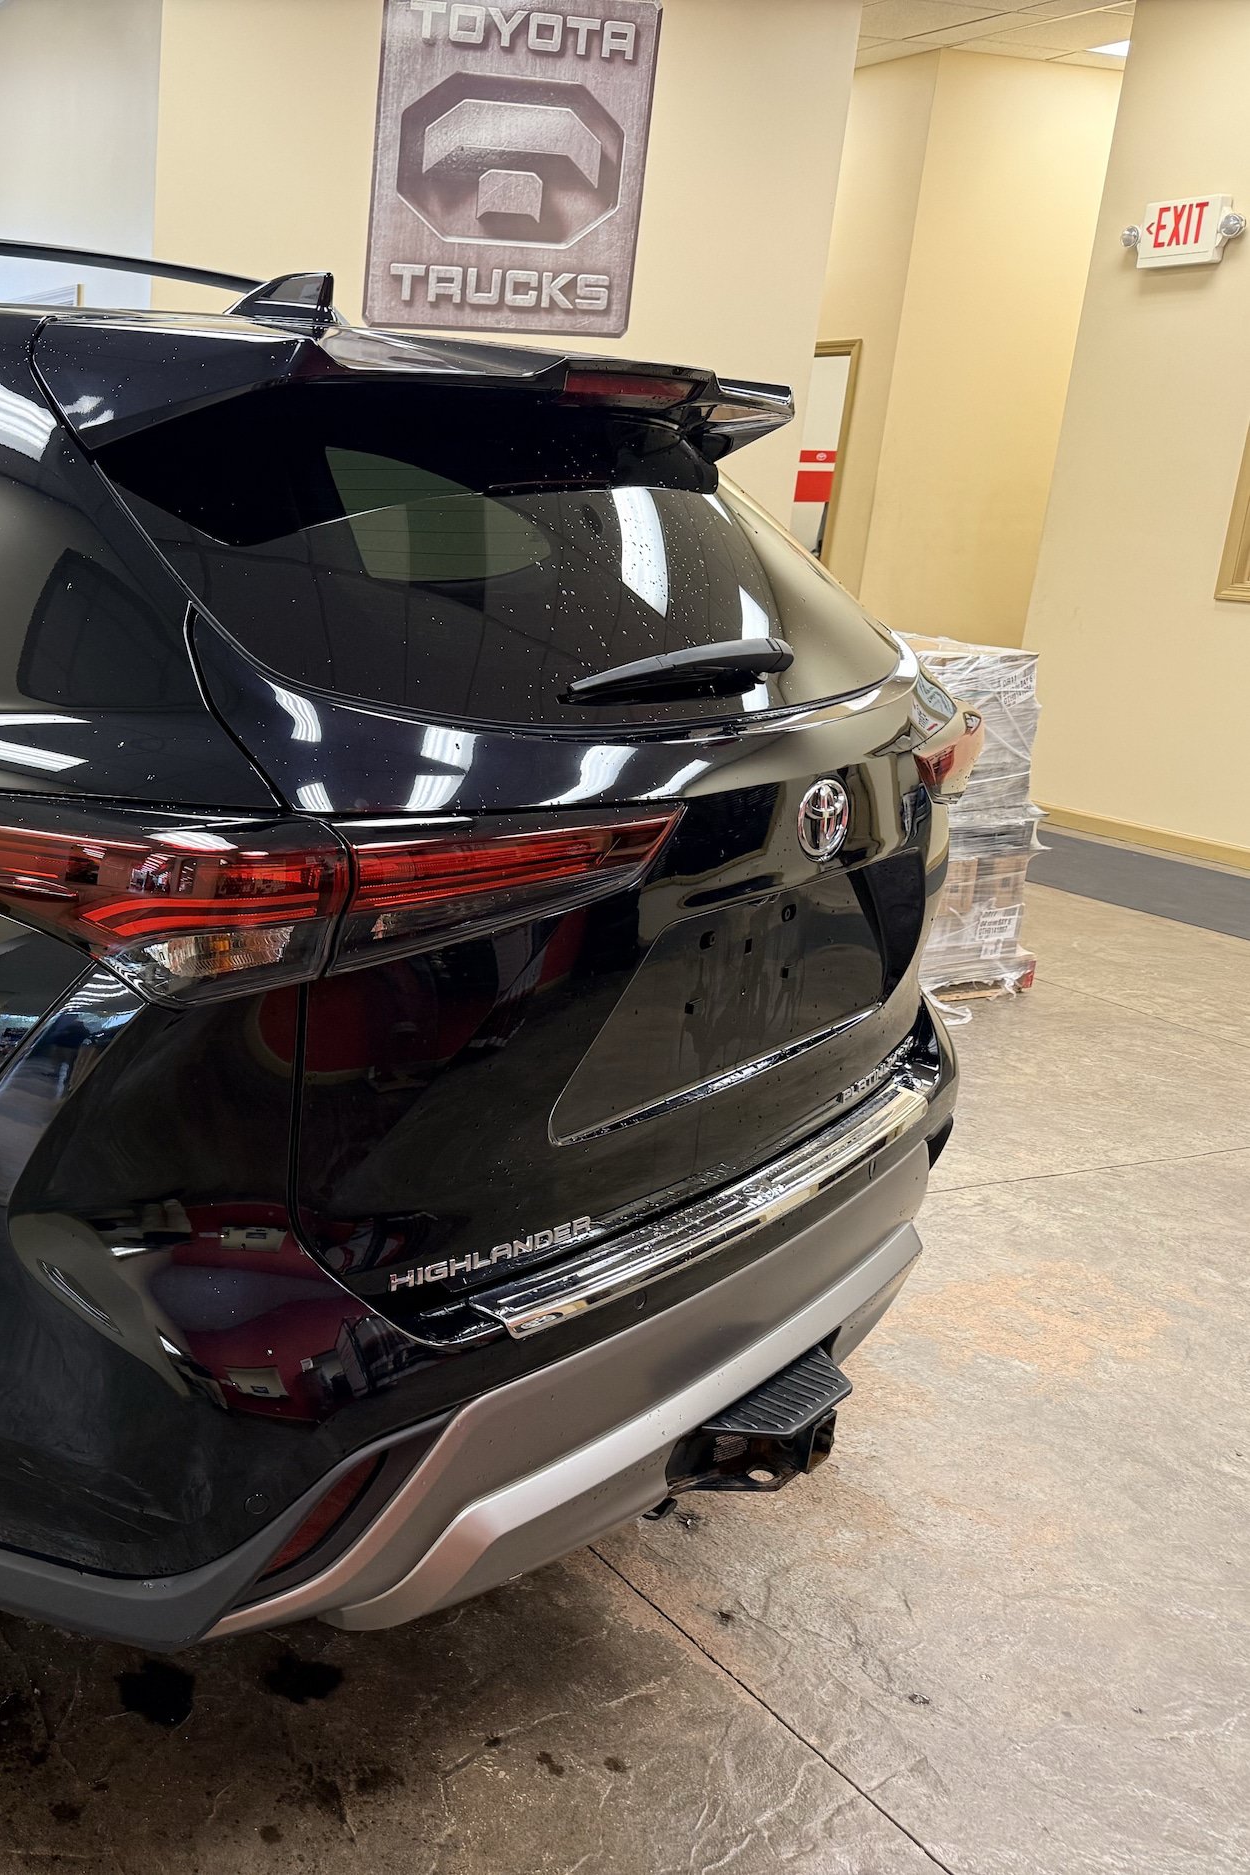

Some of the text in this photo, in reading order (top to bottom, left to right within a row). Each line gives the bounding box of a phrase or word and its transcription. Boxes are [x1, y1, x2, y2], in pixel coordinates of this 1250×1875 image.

[410, 1, 637, 60] TOYOTA
[1153, 202, 1210, 248] EXIT
[390, 263, 610, 311] TRUCKS
[389, 1215, 592, 1292] HIGHLANDER
